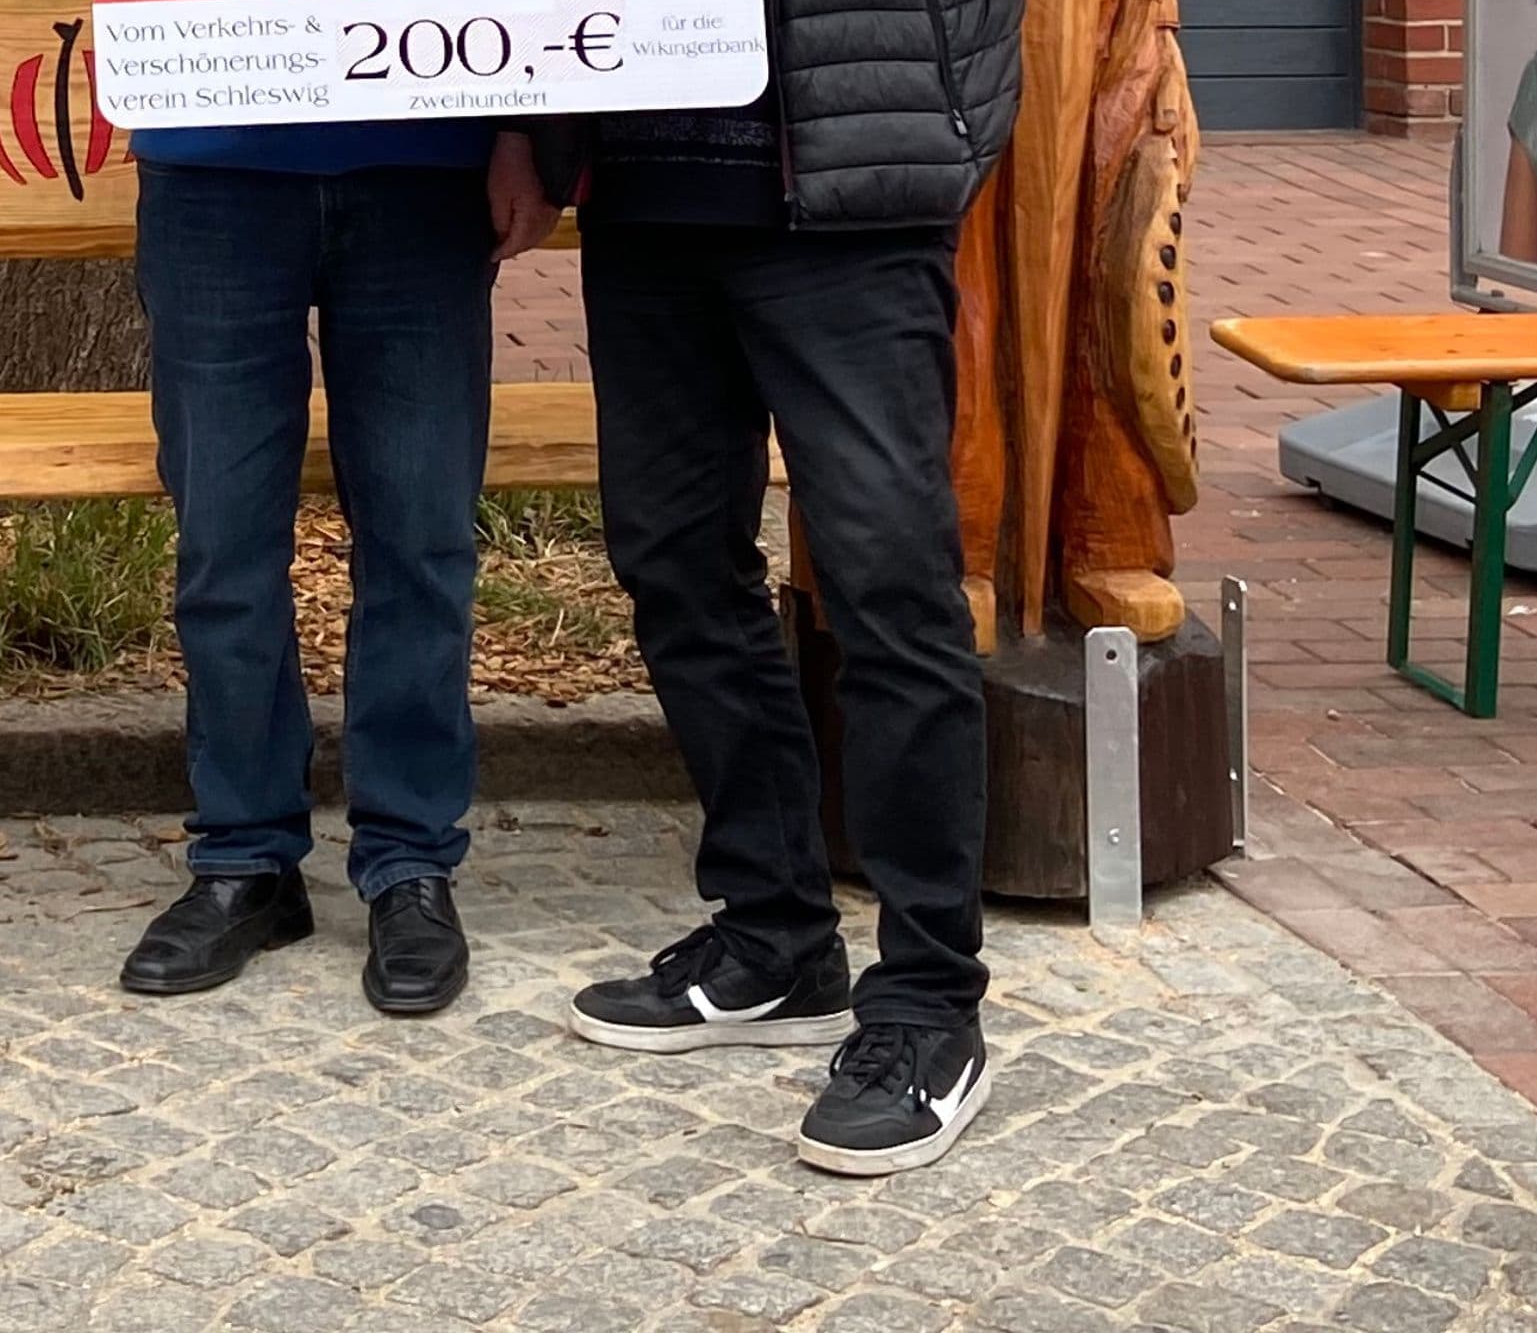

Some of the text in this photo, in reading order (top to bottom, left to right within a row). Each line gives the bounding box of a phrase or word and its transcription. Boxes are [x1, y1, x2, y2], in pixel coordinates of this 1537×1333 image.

[106, 14, 323, 43] Vom Verkehrs- &
[662, 14, 724, 32] für die
[632, 39, 766, 59] Wikingerbank
[105, 50, 328, 77] Verschönerungs-
[106, 82, 331, 112] verein Schleswig
[409, 89, 549, 111] zweihundert
